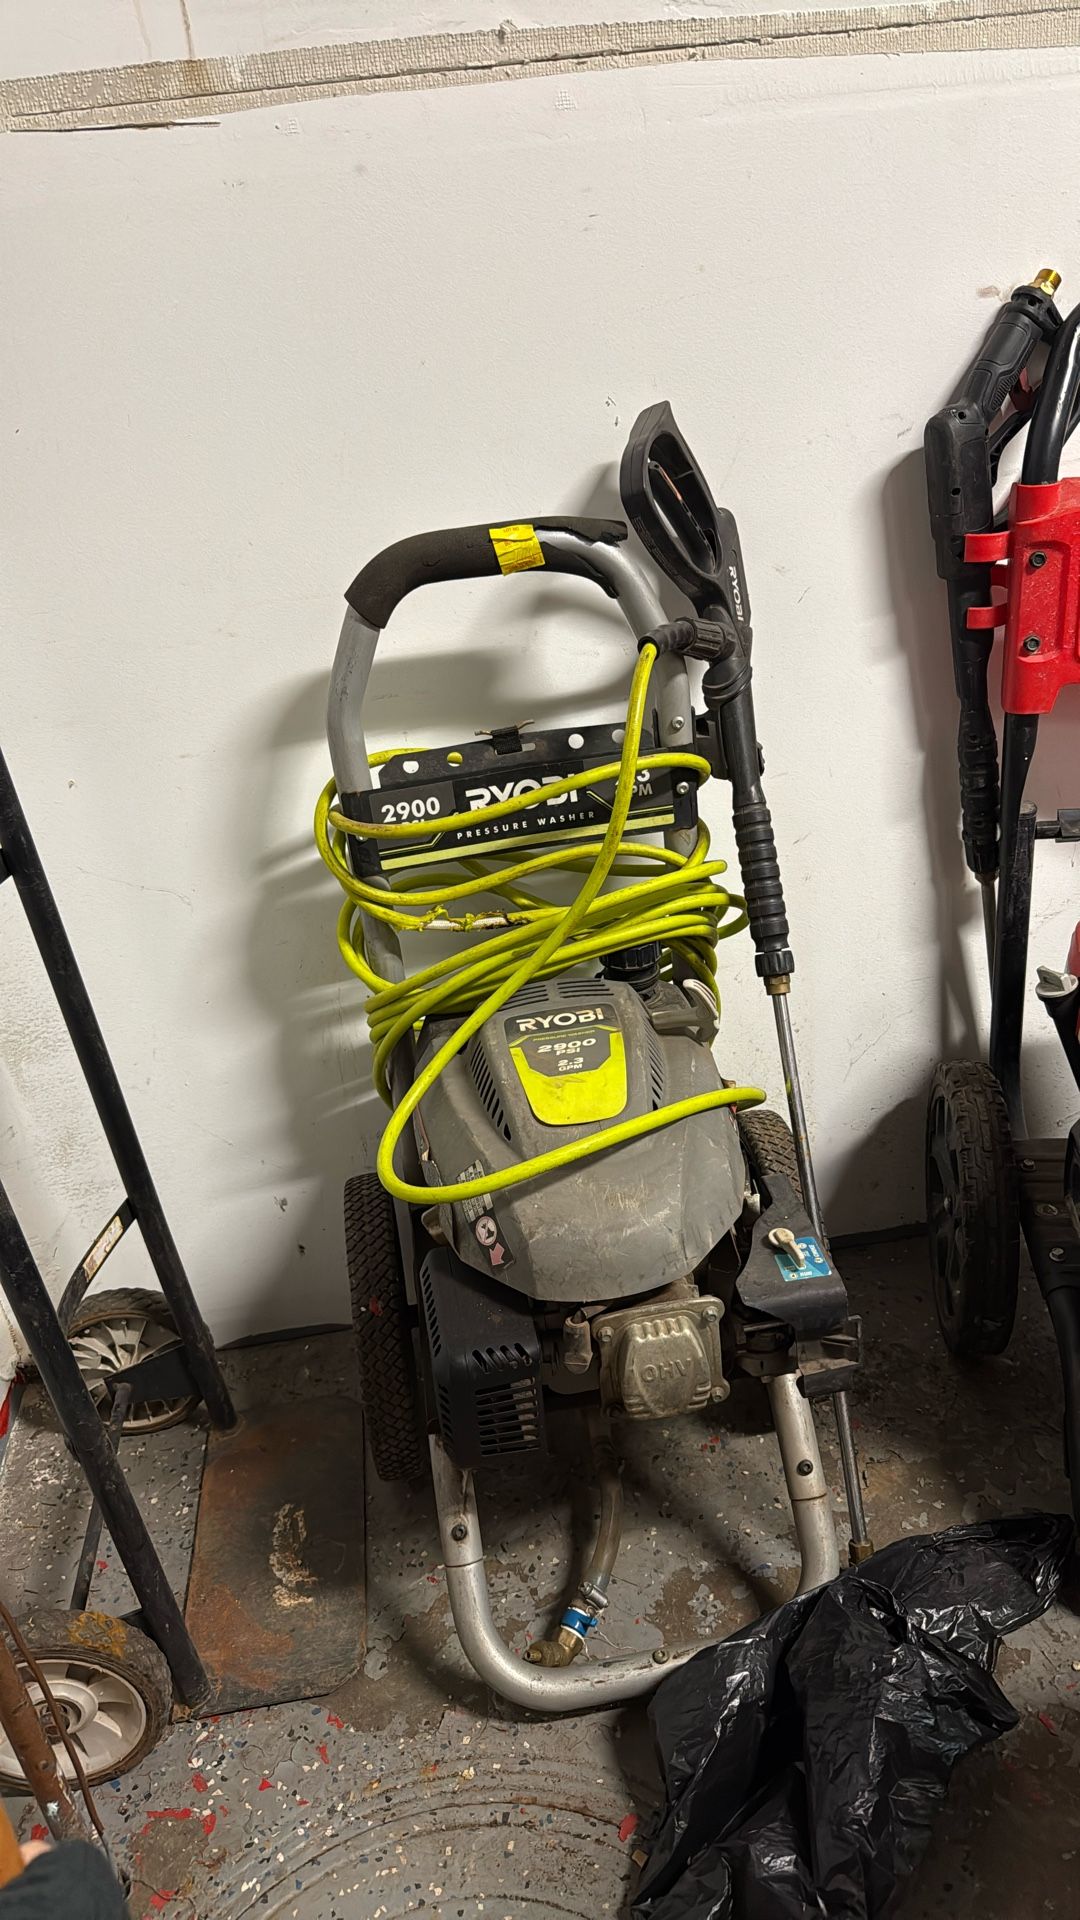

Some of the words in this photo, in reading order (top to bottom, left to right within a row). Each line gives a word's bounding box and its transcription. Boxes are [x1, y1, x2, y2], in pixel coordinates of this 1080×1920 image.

[728, 565, 744, 622] RYOBI
[381, 796, 440, 824] 2900
[456, 820, 528, 840] PRESSURE
[537, 811, 595, 826] WASHER
[516, 1008, 604, 1032] RYOBI
[537, 1038, 597, 1053] 2900
[555, 1047, 581, 1056] PSI
[557, 1057, 584, 1067] 2.3
